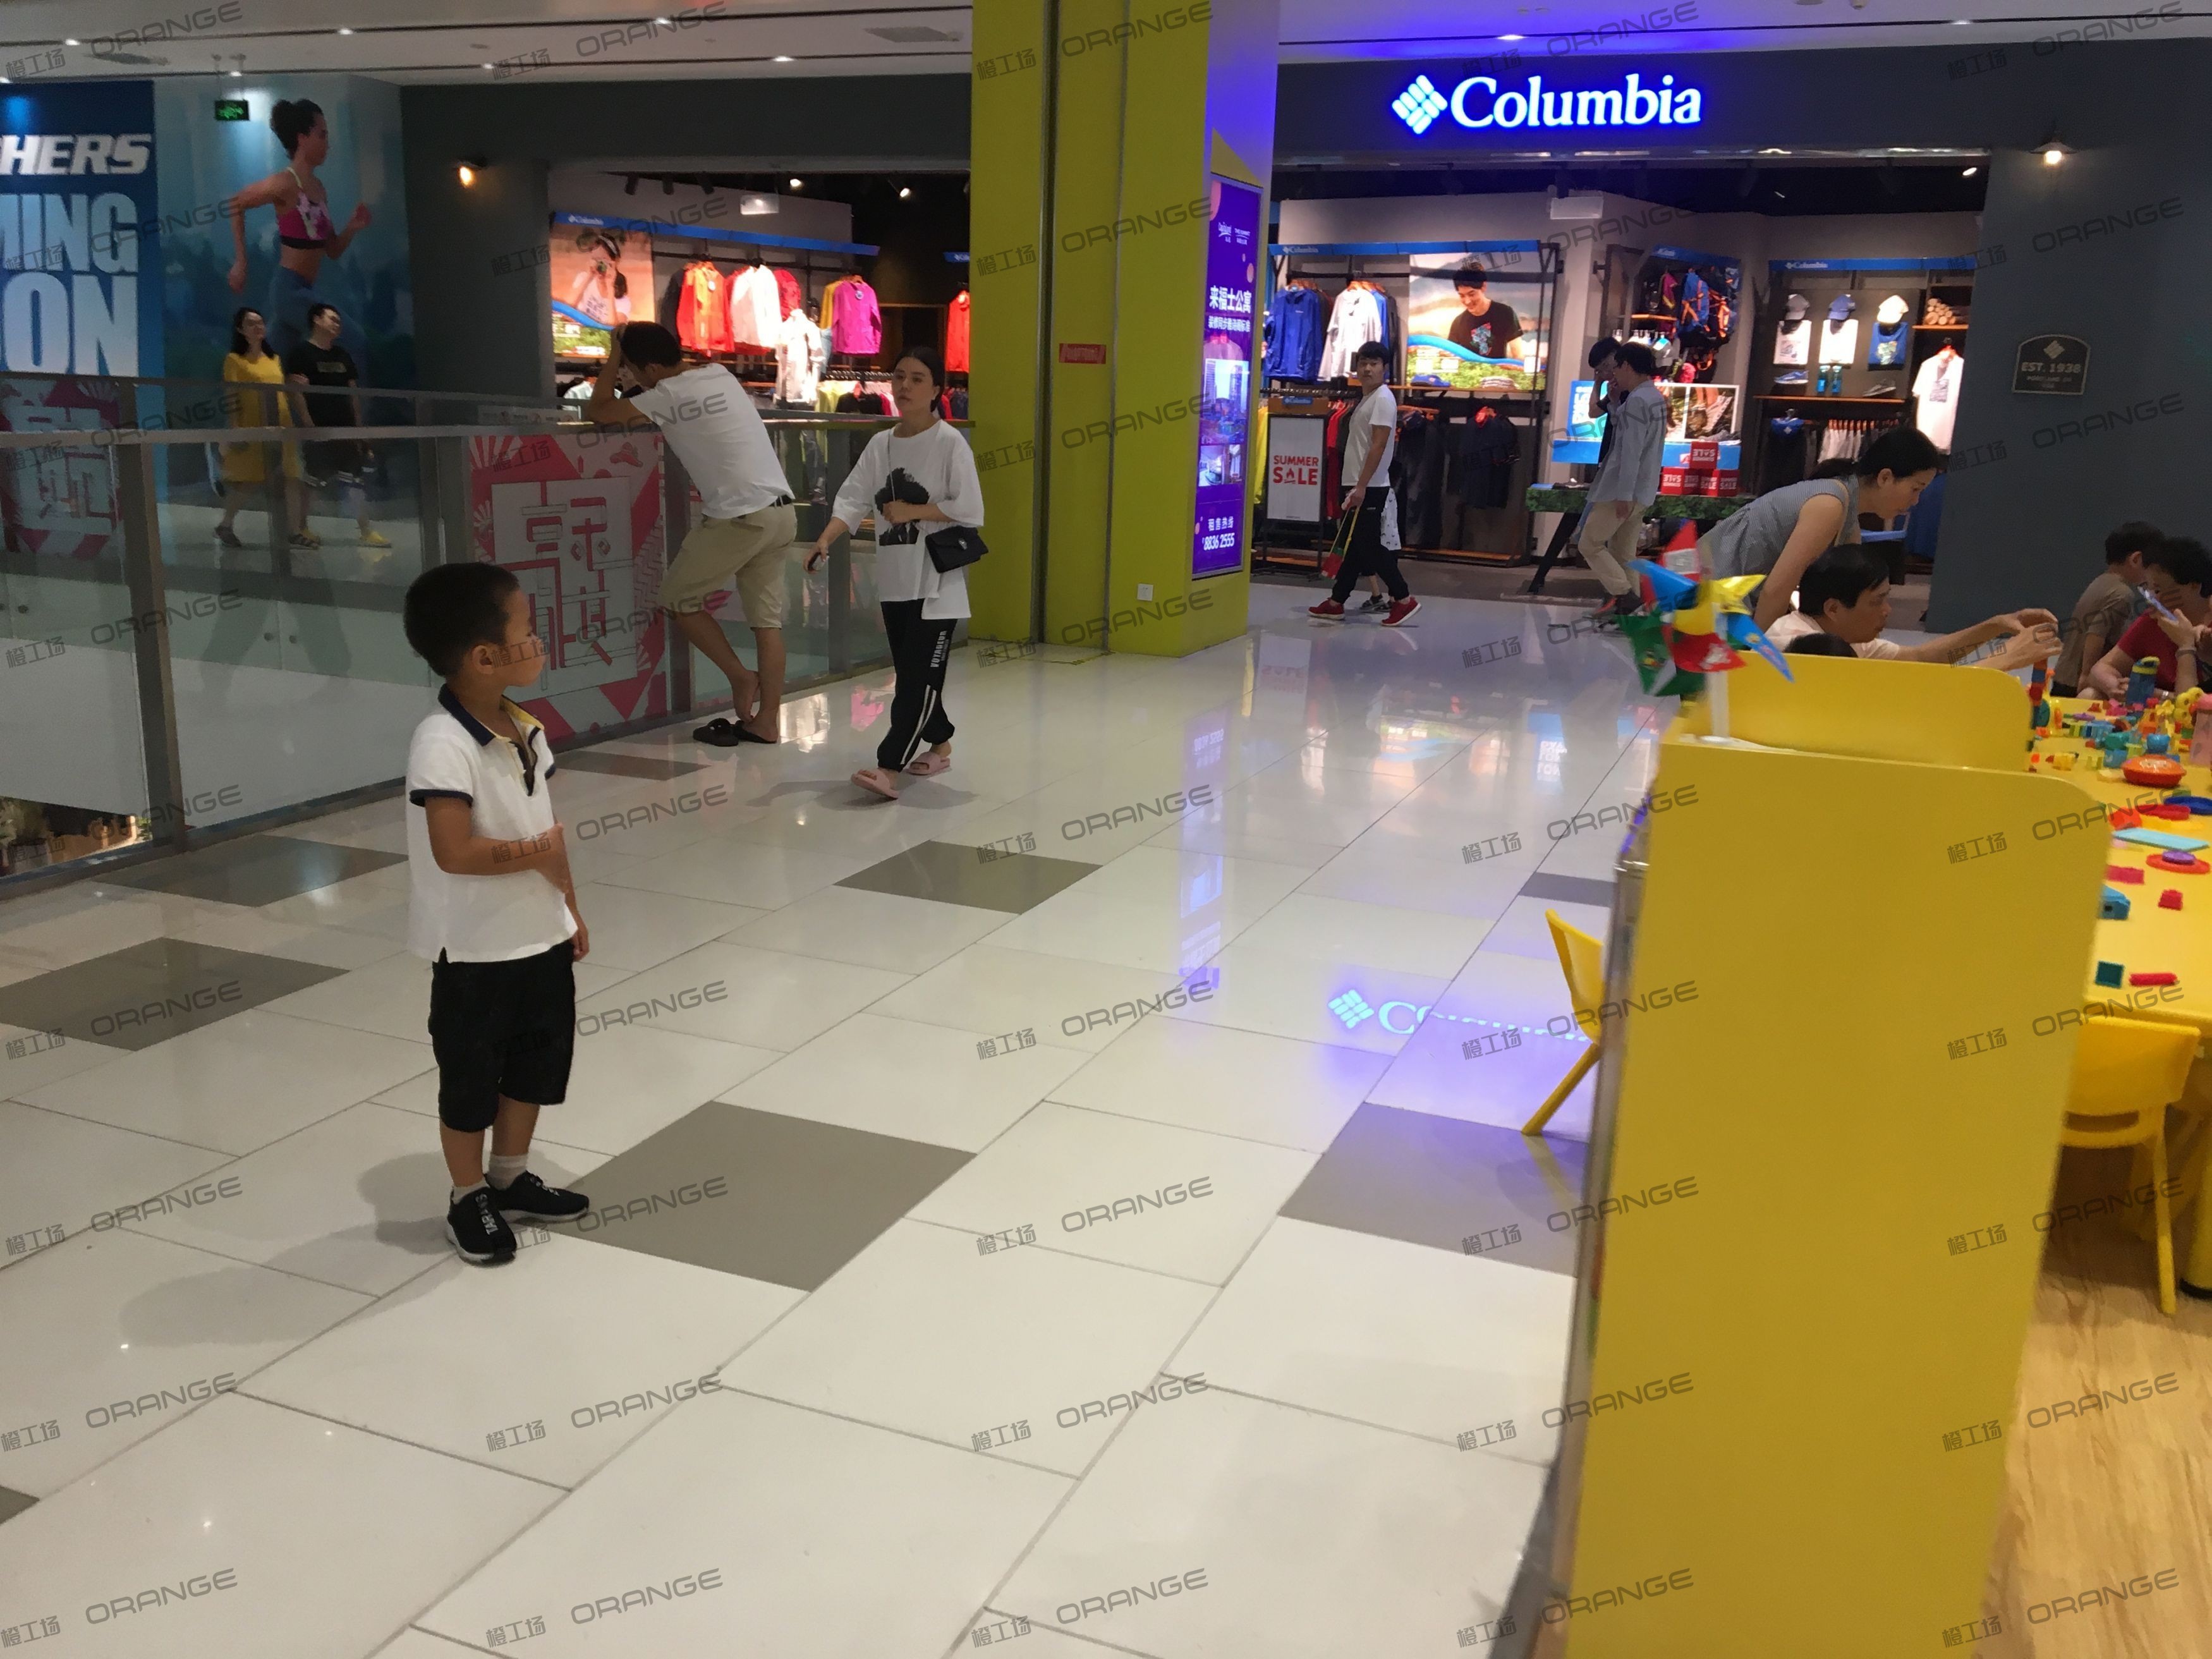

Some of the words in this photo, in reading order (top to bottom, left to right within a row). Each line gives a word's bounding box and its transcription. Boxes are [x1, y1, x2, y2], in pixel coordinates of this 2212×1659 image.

[1450, 73, 1702, 128] Columbia
[0, 134, 151, 174] HERS
[1209, 285, 1252, 314] 来福士公寓
[1273, 455, 1319, 466] SUMMER
[1273, 466, 1318, 485] SALE
